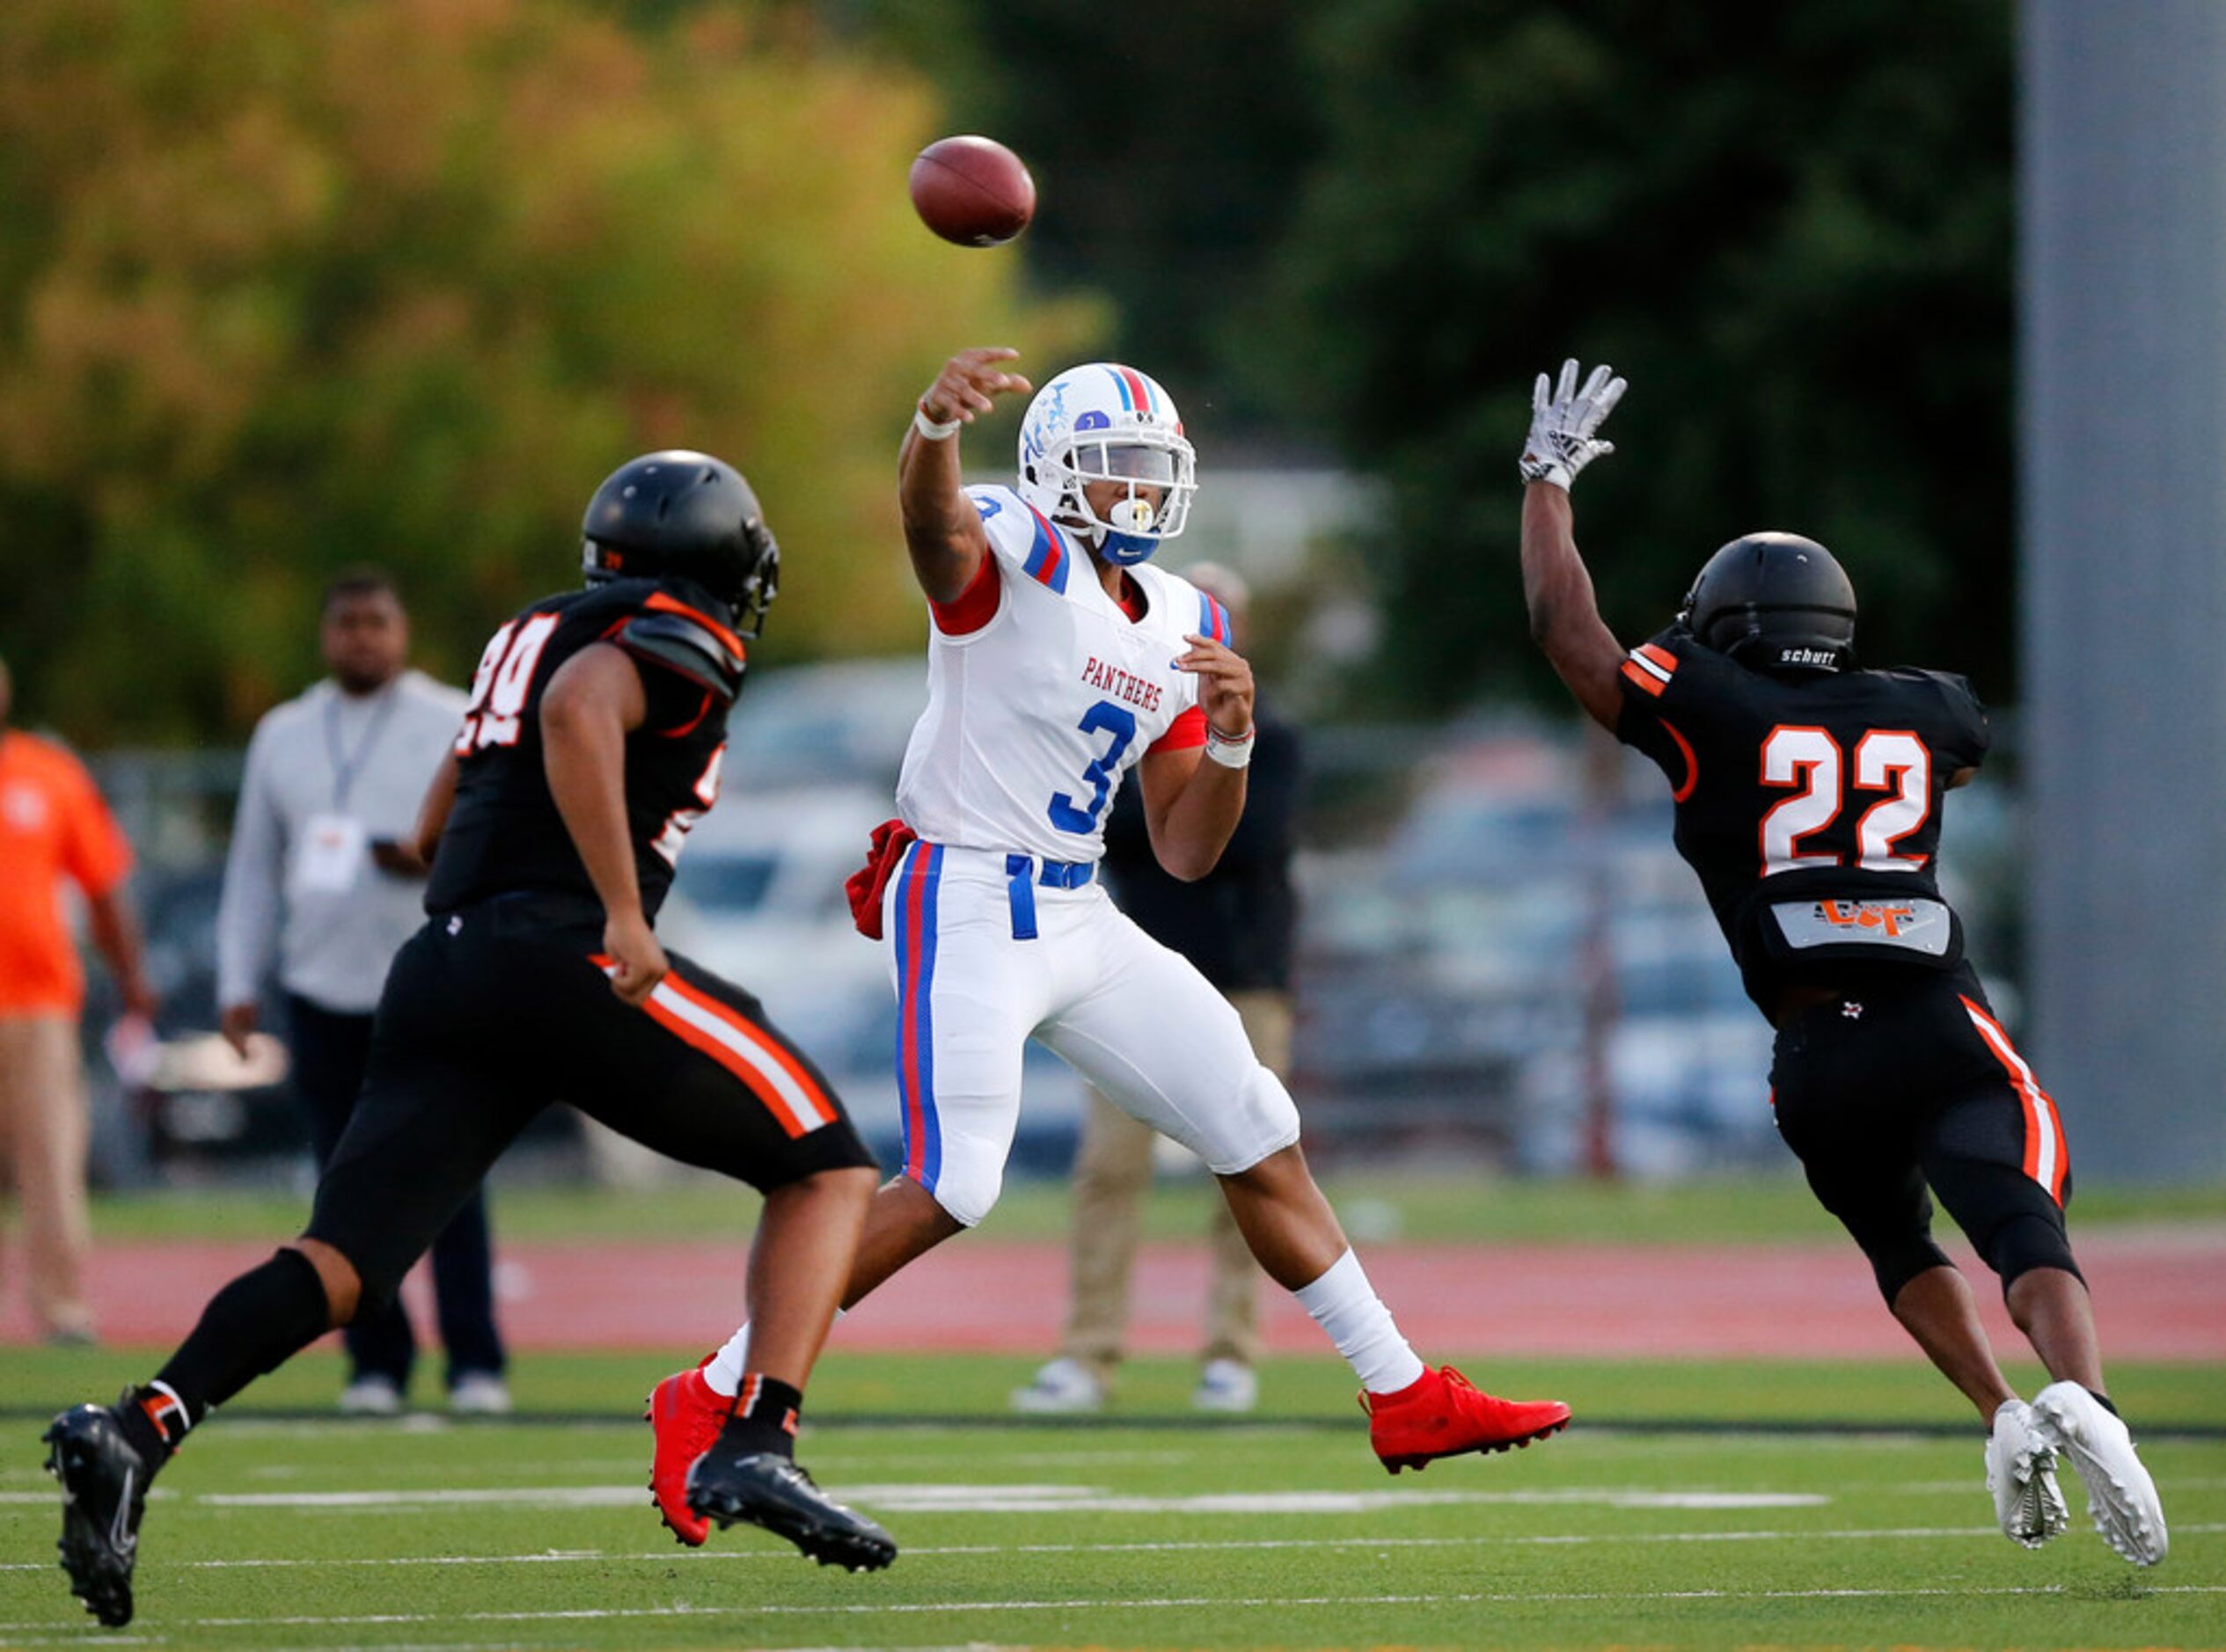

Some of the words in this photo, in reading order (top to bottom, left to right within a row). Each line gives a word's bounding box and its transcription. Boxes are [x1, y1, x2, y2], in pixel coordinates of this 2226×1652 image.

[1081, 656, 1163, 713] PANTHERS
[1781, 647, 1836, 666] schutt
[1047, 700, 1137, 835] 3
[1760, 724, 1932, 878] 22
